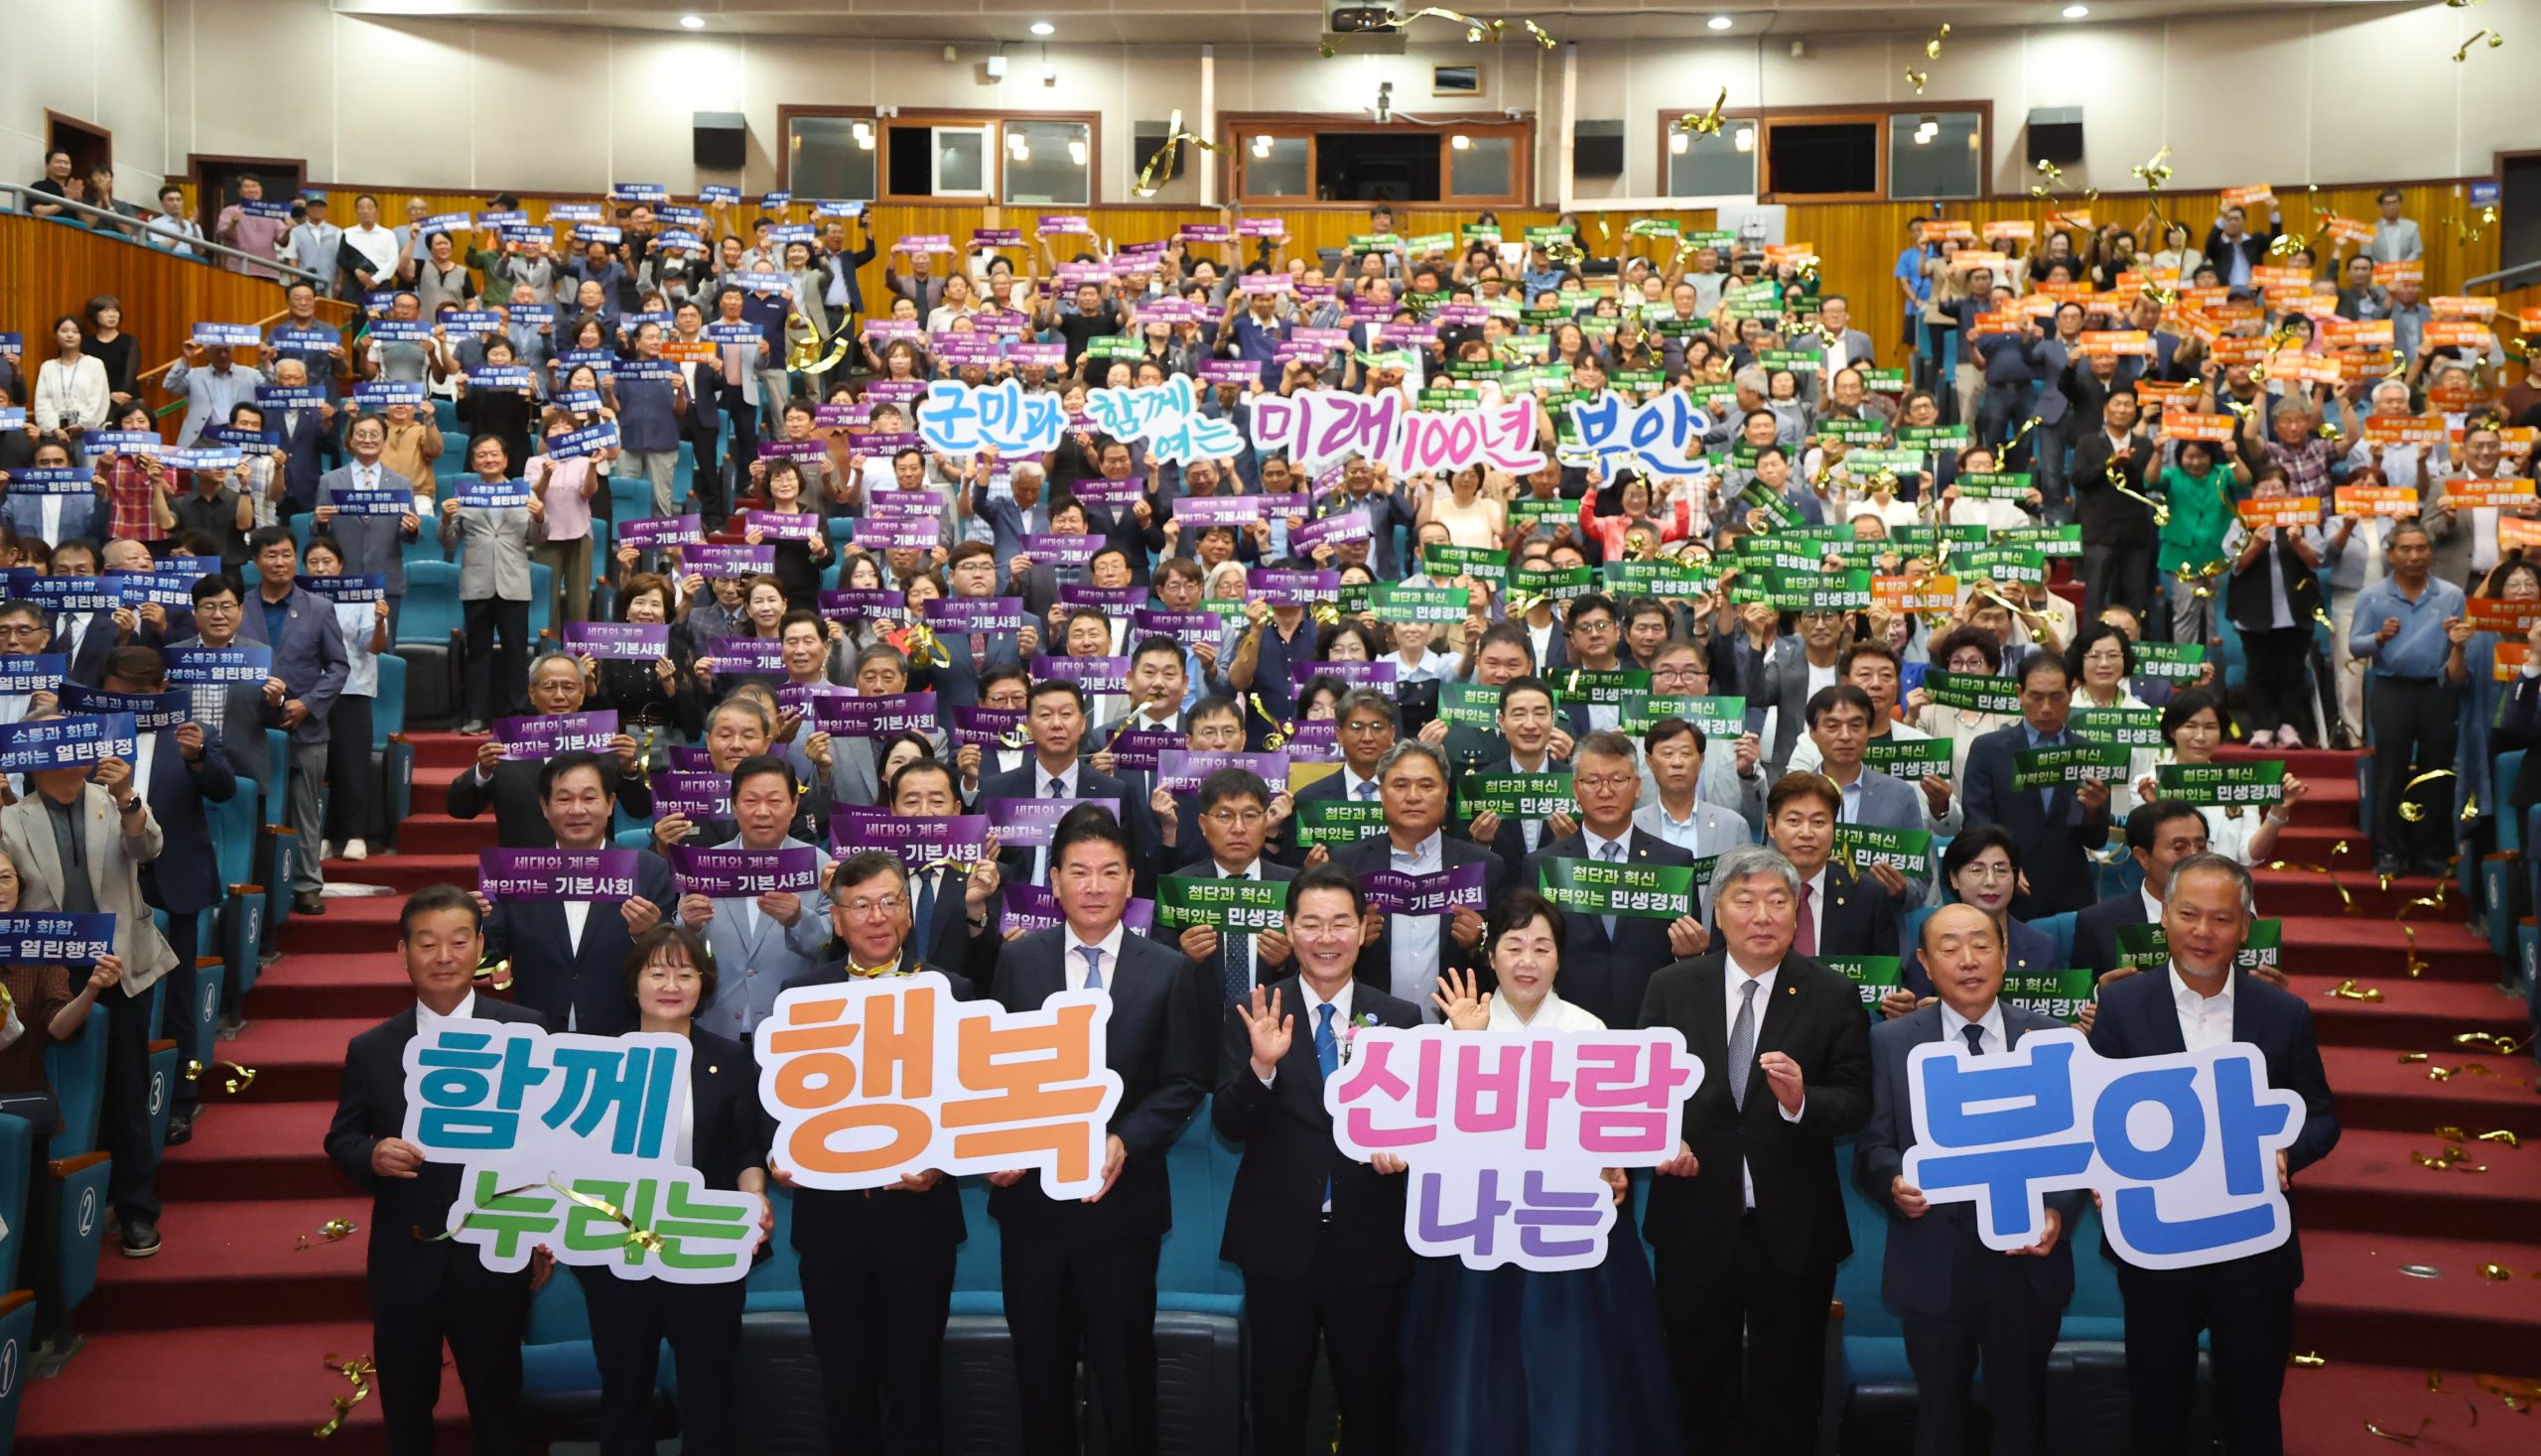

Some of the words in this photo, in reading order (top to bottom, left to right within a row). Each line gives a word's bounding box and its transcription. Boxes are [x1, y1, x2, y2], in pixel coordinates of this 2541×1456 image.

[924, 385, 1063, 450] 군민과
[1090, 375, 1190, 438] 함께
[1156, 418, 1239, 459] 여는
[1259, 394, 1395, 462] 미래
[1402, 400, 1541, 473] 100년
[1558, 394, 1704, 478] 부안
[24, 471, 52, 480] 소통과
[48, 482, 92, 492] 열린행정
[470, 485, 494, 494] 소통과
[346, 493, 372, 502] 소통과
[491, 495, 528, 505] 열린행정
[368, 503, 410, 513] 열린행정
[904, 504, 941, 515] 기본사회
[1213, 512, 1257, 522] 기본사회
[1541, 513, 1578, 523] 민생경제
[655, 530, 700, 545] 기본사회
[779, 527, 816, 537] 기본사회
[1324, 526, 1366, 544] 기본사회
[893, 534, 937, 545] 기본사회
[1750, 539, 1779, 552] 첨단과
[2035, 541, 2081, 553] 민생경제
[1441, 549, 1468, 560] 첨단과
[726, 561, 773, 574] 기본사회
[1776, 555, 1820, 572] 민생경제
[1462, 564, 1506, 578] 민생경제
[1625, 566, 1653, 577] 첨단과
[1657, 567, 1683, 579] 혁신,
[1992, 568, 2043, 582] 민생경제
[32, 581, 67, 593] 소통과
[70, 582, 98, 593] 화합,
[122, 576, 155, 587] 소통과
[158, 578, 183, 590] 화합,
[1652, 580, 1702, 594] 민생경제
[1785, 577, 1819, 589] 첨단과
[1822, 576, 1849, 589] 혁신,
[337, 589, 384, 600] 열린행정
[1290, 589, 1339, 601] 기본사회
[1390, 592, 1420, 602] 첨단과
[1424, 593, 1448, 604] 혁신,
[1813, 592, 1871, 606] 민생경제
[63, 596, 120, 608] 열린행정
[944, 603, 975, 614] 세대와
[863, 605, 902, 619] 기본사회
[1416, 606, 1467, 620] 민생경제
[925, 617, 967, 629] 책임지는
[971, 615, 1021, 629] 기본사회
[588, 626, 622, 637] 세대와
[1176, 629, 1221, 642] 기본사회
[567, 642, 609, 654] 책임지는
[613, 641, 666, 655] 기본사회
[2154, 648, 2181, 660] 혁신,
[181, 652, 216, 665] 소통과
[220, 652, 247, 665] 화합,
[8, 660, 39, 673] 화합,
[211, 666, 268, 681] 열린행정
[2145, 662, 2202, 677] 민생경제
[1948, 677, 1985, 692] 첨단과
[1989, 680, 2016, 694] 혁신,
[82, 694, 122, 710] 소통과
[126, 699, 160, 712] 화합,
[1464, 691, 1500, 704] 첨단과
[842, 701, 878, 717] 세대와
[882, 698, 906, 714] 계층
[1441, 708, 1490, 721] 활력있는
[1649, 701, 1686, 714] 첨단과
[1689, 702, 1718, 715] 혁신,
[521, 721, 559, 733] 세대와
[563, 718, 588, 730] 계층
[818, 719, 869, 731] 책임지는
[873, 715, 935, 731] 기본사회
[976, 715, 1010, 727] 세대와
[2085, 712, 2122, 726] 첨단과
[2126, 713, 2157, 727] 혁신,
[12, 728, 61, 744] 소통과
[66, 723, 102, 738] 화합,
[1299, 727, 1336, 738] 세대와
[555, 732, 615, 751] 기본사회
[1132, 736, 1169, 748] 세대와
[0, 750, 50, 768] 생하는
[55, 737, 134, 762] 열린행정
[1901, 745, 1929, 757] 혁신,
[2037, 751, 2072, 764] 첨단과
[2075, 748, 2104, 763] 혁신,
[1188, 758, 1227, 769] 세대와
[1890, 760, 1950, 776] 민생경제
[2065, 765, 2127, 781] 민생경제
[2183, 768, 2222, 781] 첨단과
[2227, 767, 2257, 781] 혁신,
[680, 780, 721, 793] 세대와
[1485, 780, 1527, 793] 첨단과
[1532, 779, 1561, 793] 혁신,
[2217, 784, 2281, 801] 민생경제
[656, 801, 709, 815] 책임지는
[1014, 805, 1055, 818] 세대와
[1460, 800, 1515, 814] 활력있는
[1325, 808, 1366, 821] 첨단과
[865, 823, 911, 838] 세대와
[917, 823, 948, 838] 계층
[988, 827, 1043, 840] 책임지는
[1300, 826, 1354, 841] 활력있는
[1868, 833, 1900, 850] 혁신,
[905, 844, 981, 861] 기본사회
[513, 856, 562, 871] 세대와
[568, 856, 601, 870] 계층
[697, 856, 743, 869] 세대와
[748, 856, 780, 869] 계층
[675, 872, 732, 891] 책임지는
[737, 870, 815, 891] 기본사회
[1374, 875, 1416, 891] 세대와
[1572, 865, 1619, 884] 첨단과
[1624, 870, 1661, 888] 혁신,
[482, 879, 548, 893] 책임지는
[555, 877, 633, 895] 기본사회
[1188, 885, 1235, 902] 첨단과
[1241, 888, 1276, 905] 혁신,
[1409, 886, 1482, 910] 기본사회
[1543, 887, 1605, 906] 활력있는
[1611, 890, 1688, 913] 민생경제
[1161, 905, 1221, 925] 활력있는
[1228, 907, 1284, 928] 민생경
[0, 919, 31, 934] 통과
[37, 920, 77, 936] 화합,
[21, 940, 108, 959] 열린행정
[2025, 979, 2062, 993] 혁신,
[770, 988, 1108, 1184] 행복
[417, 1031, 678, 1159] 함께
[1338, 1040, 1693, 1153] 신바람
[1918, 1041, 2290, 1255] 부안
[1419, 1168, 1603, 1257] 나는
[465, 1170, 750, 1270] 누리는
